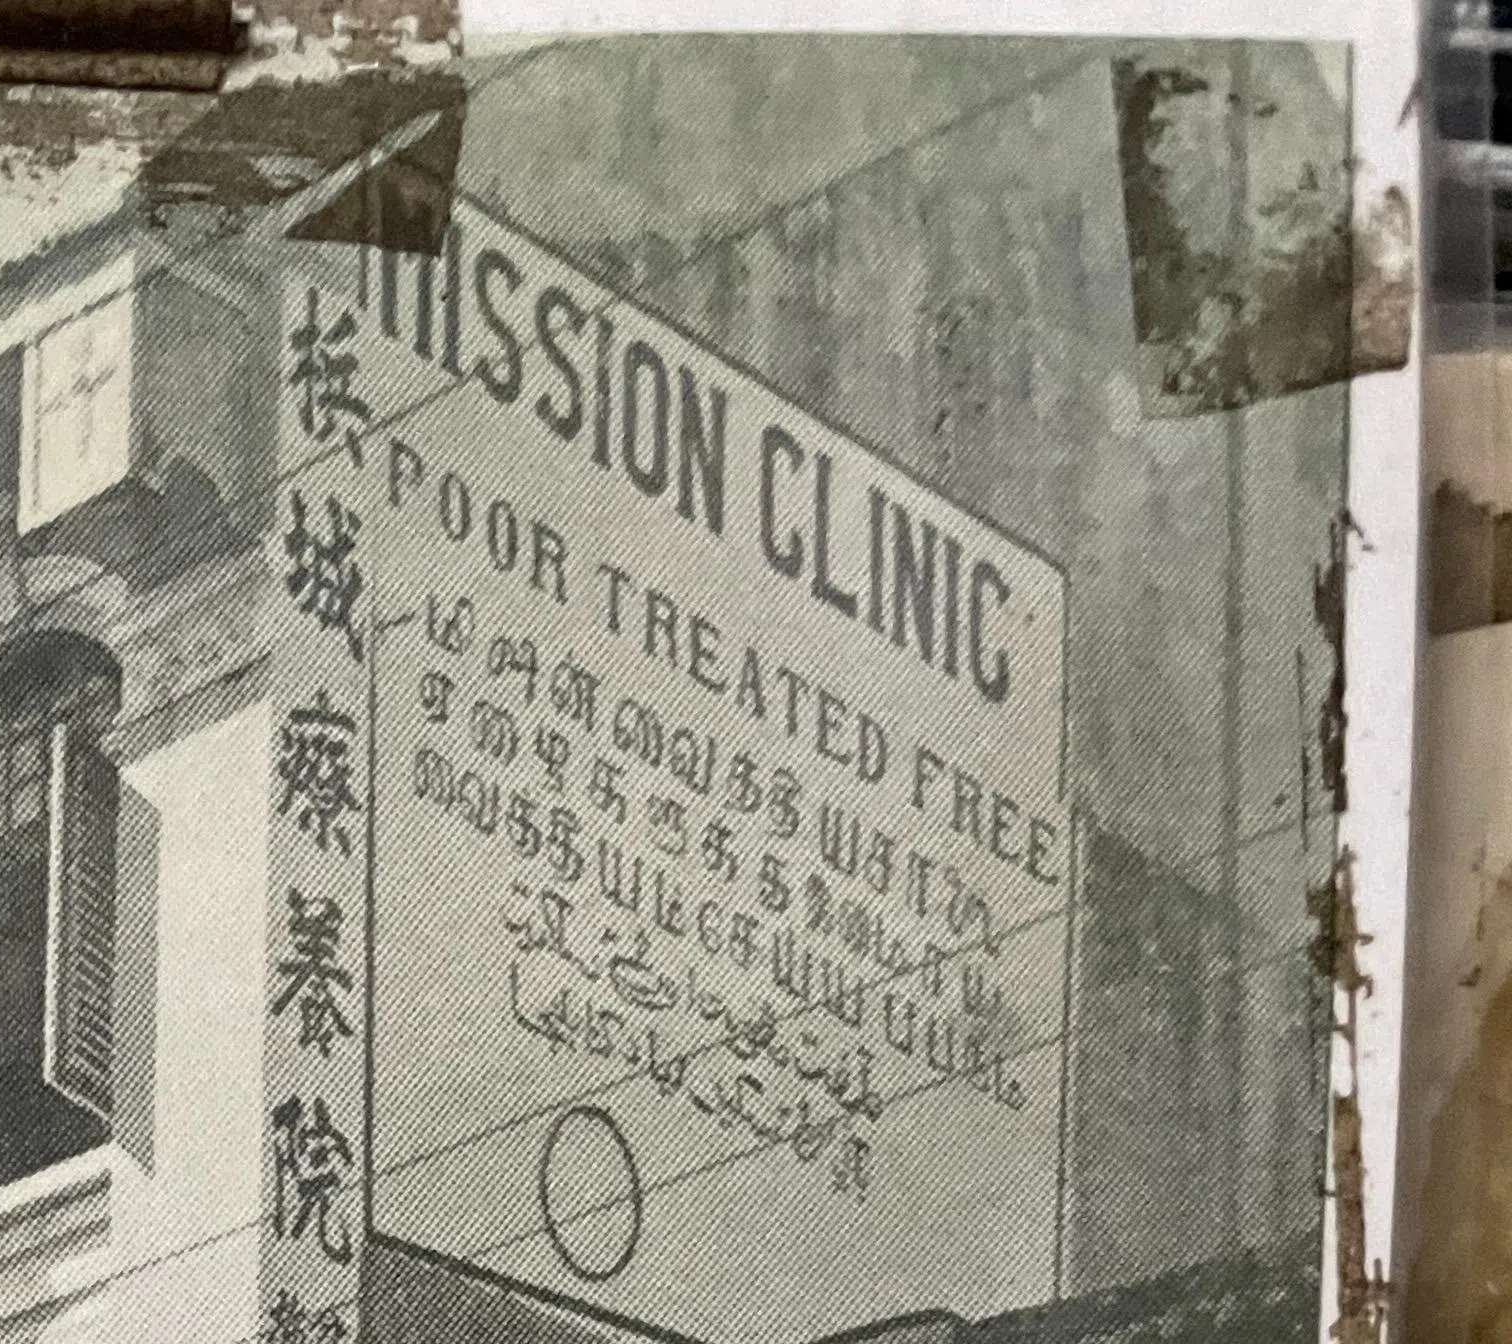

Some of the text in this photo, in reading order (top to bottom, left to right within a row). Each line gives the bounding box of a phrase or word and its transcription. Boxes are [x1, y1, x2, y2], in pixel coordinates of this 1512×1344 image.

[356, 222, 1011, 704] MISSION CLINIC
[387, 440, 1059, 887] POOR TREATED FREE
